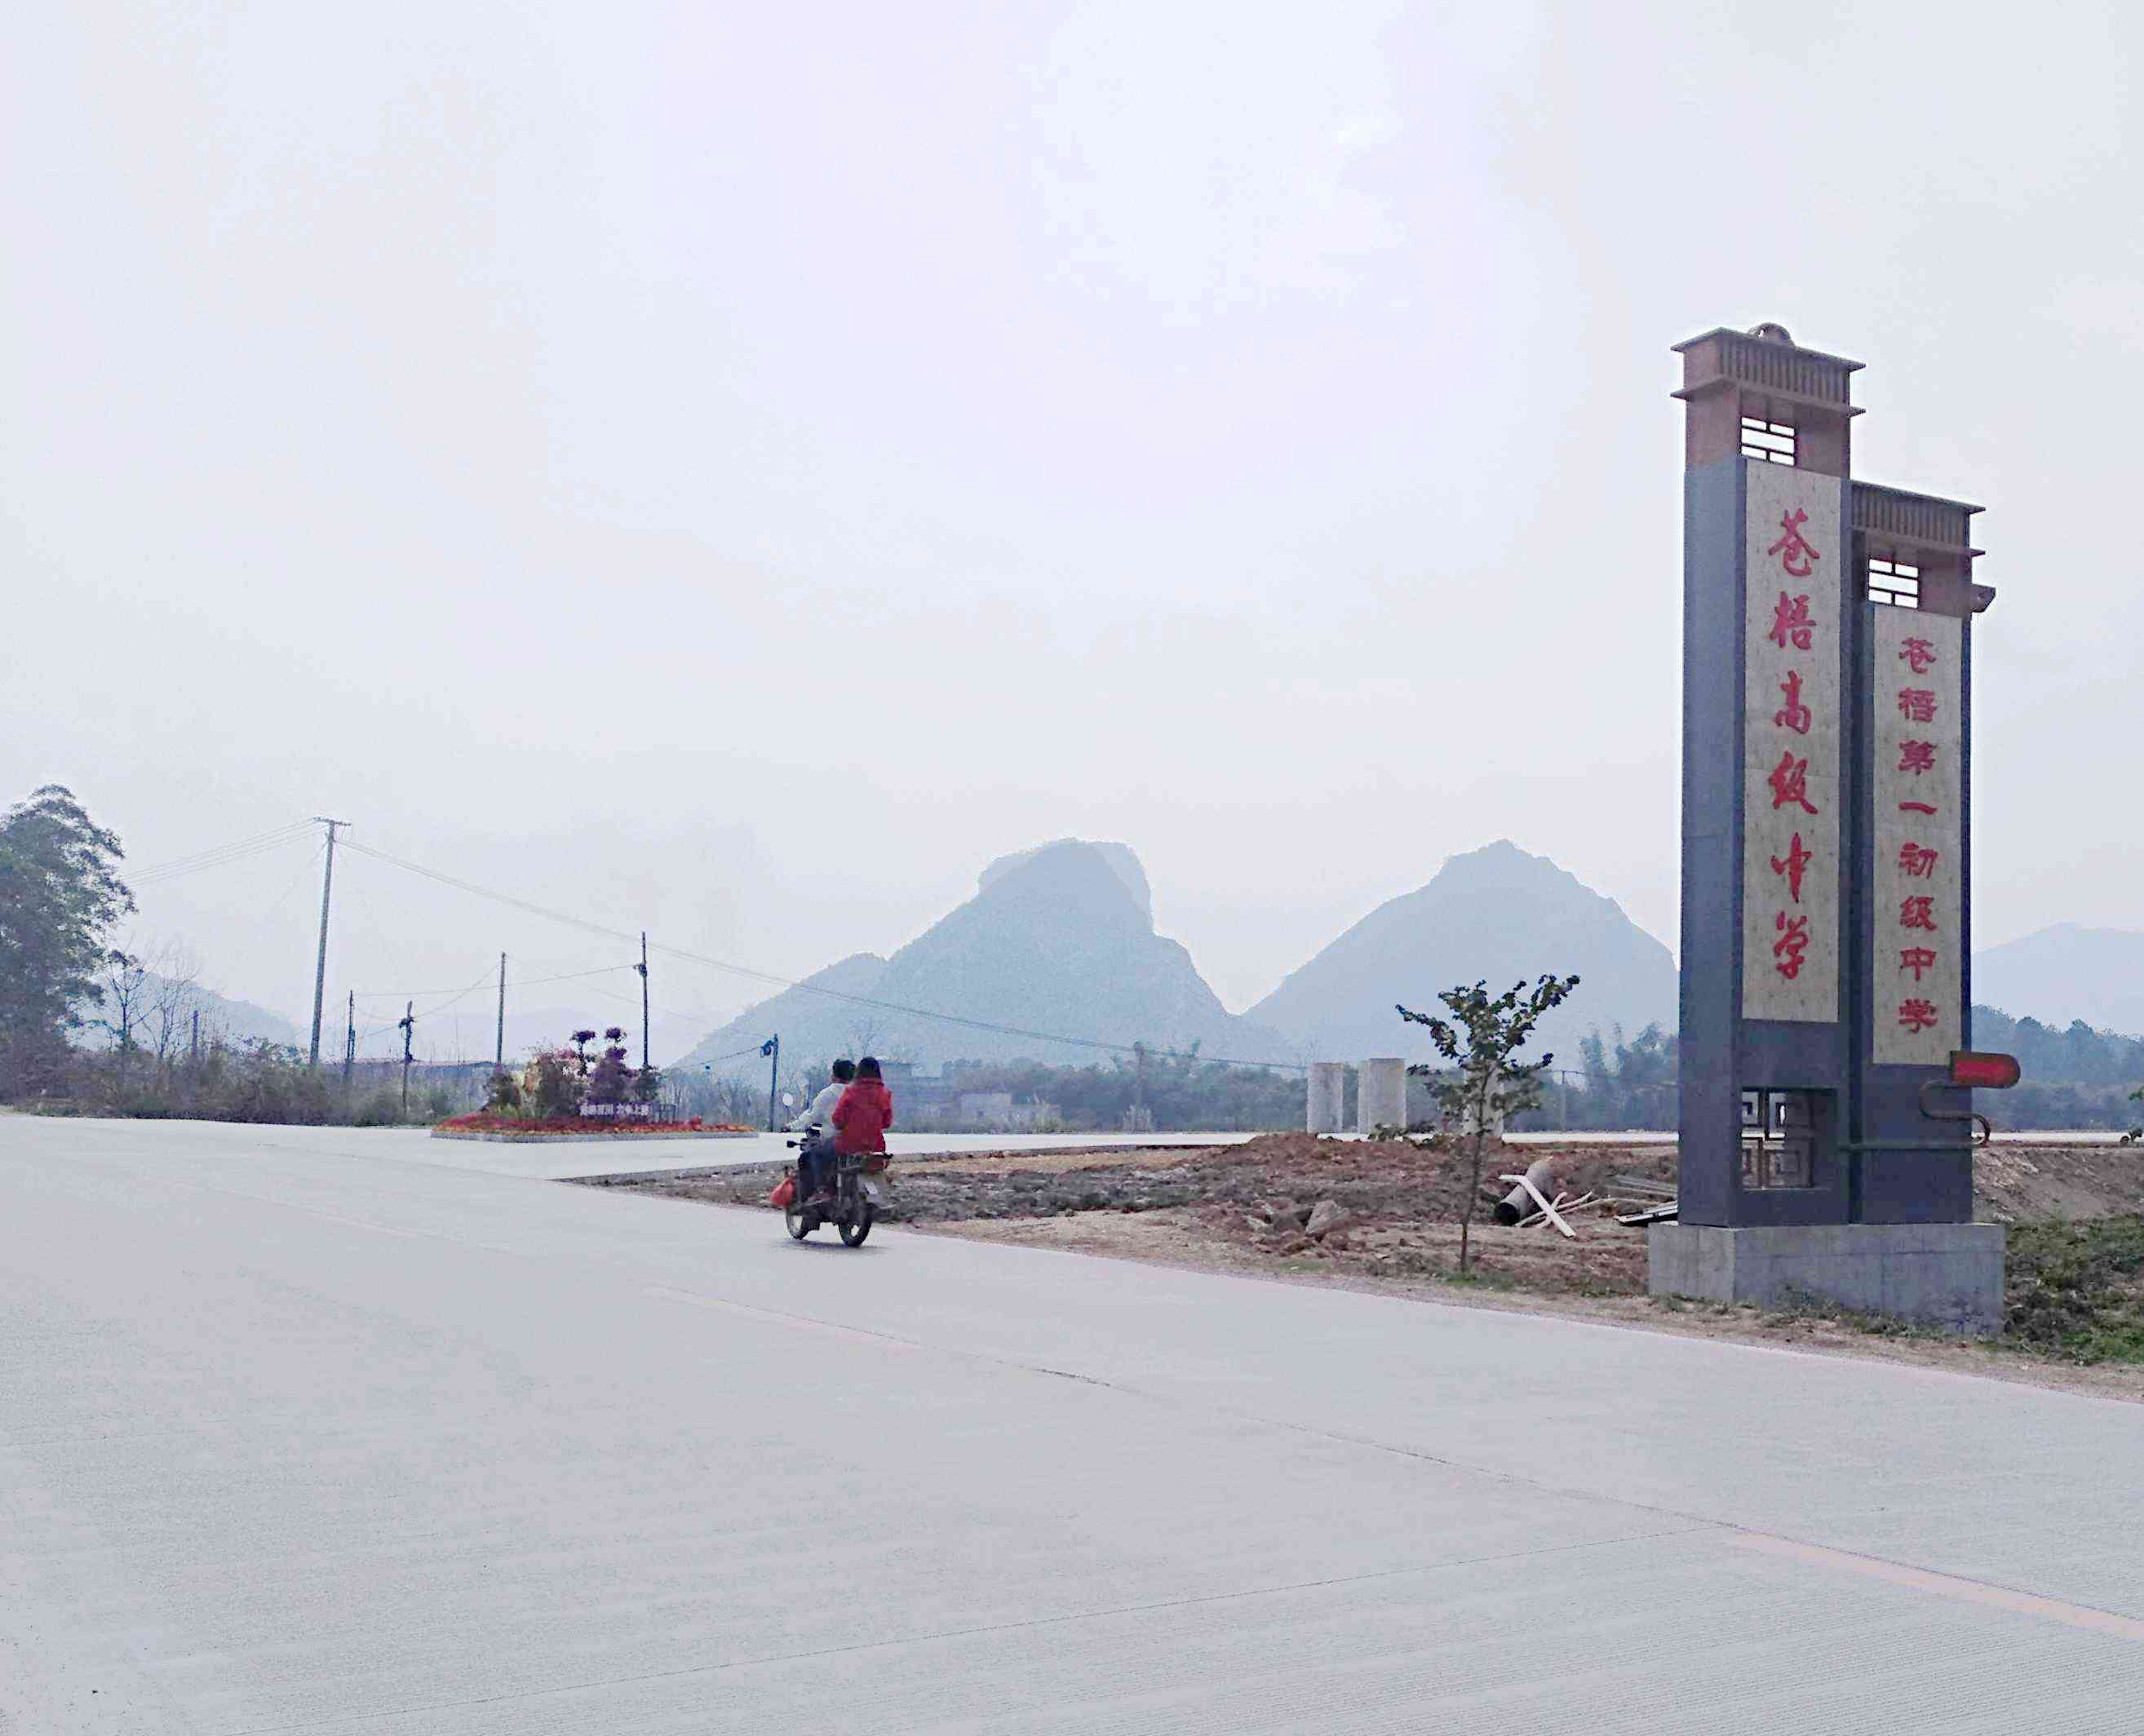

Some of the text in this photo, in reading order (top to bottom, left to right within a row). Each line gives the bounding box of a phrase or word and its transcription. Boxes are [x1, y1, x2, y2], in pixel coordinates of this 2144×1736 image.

[1768, 507, 1820, 980] 苍梧高级中学
[1898, 636, 1938, 1033] 苍梧第一初级中学
